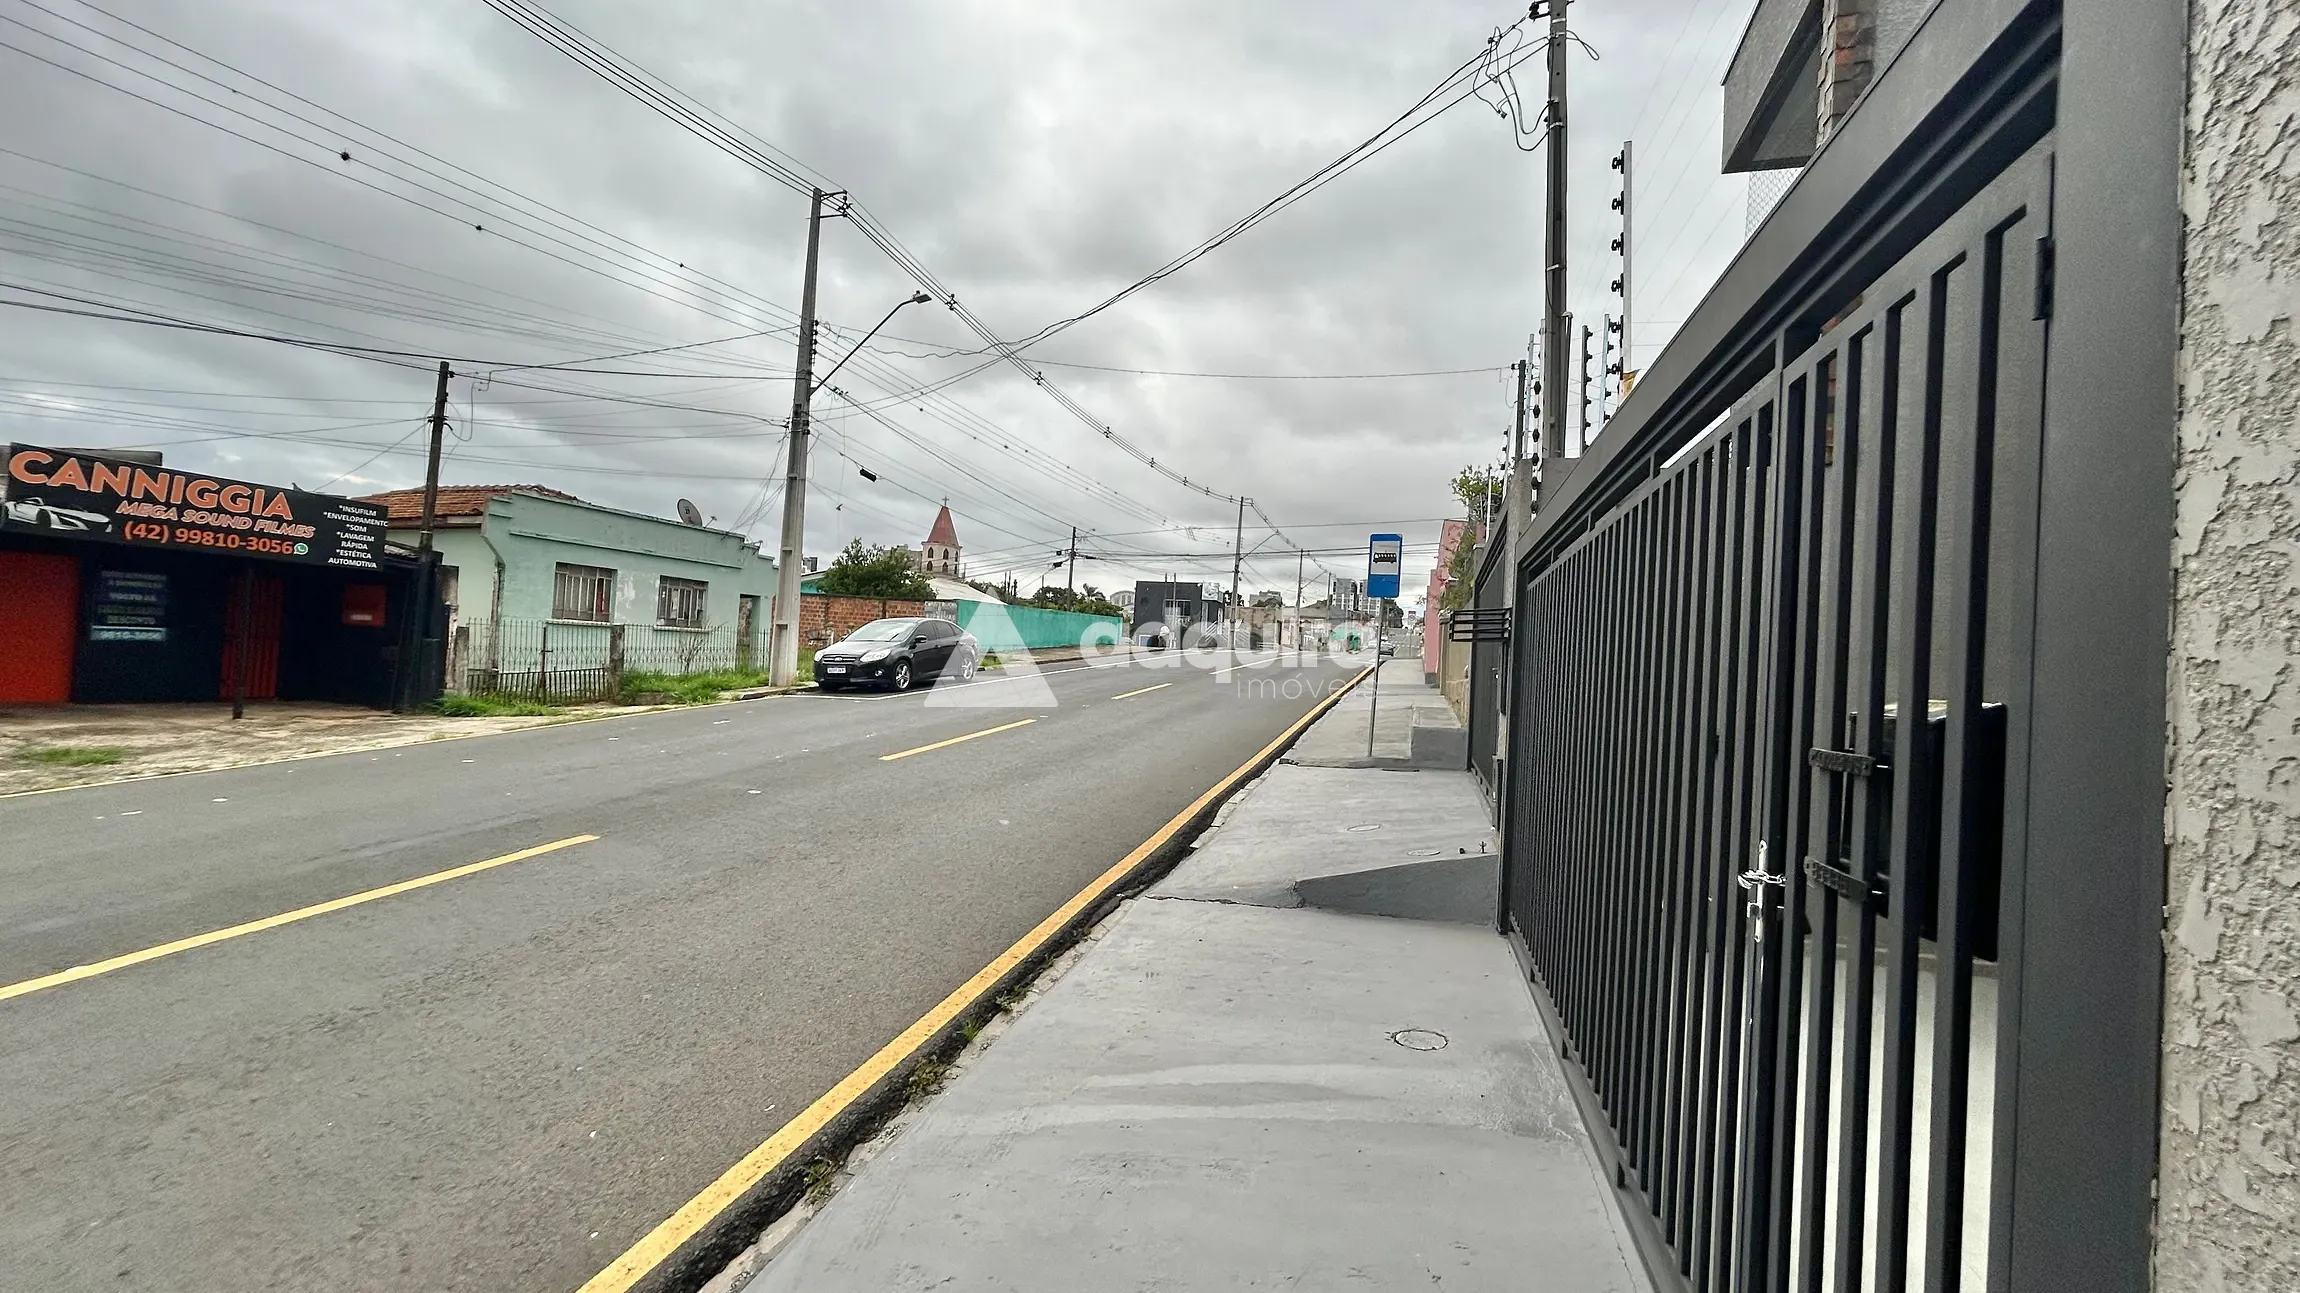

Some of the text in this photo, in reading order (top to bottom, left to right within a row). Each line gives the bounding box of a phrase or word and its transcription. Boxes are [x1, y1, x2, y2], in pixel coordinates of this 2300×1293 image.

[8, 450, 293, 520] CANNIGGIA
[116, 501, 316, 538] MEGA SOUND FILMES
[123, 521, 294, 555] (42) 99810-3056
[341, 540, 369, 550] RÁPIDA
[327, 557, 378, 568] AUTOMOTIVA
